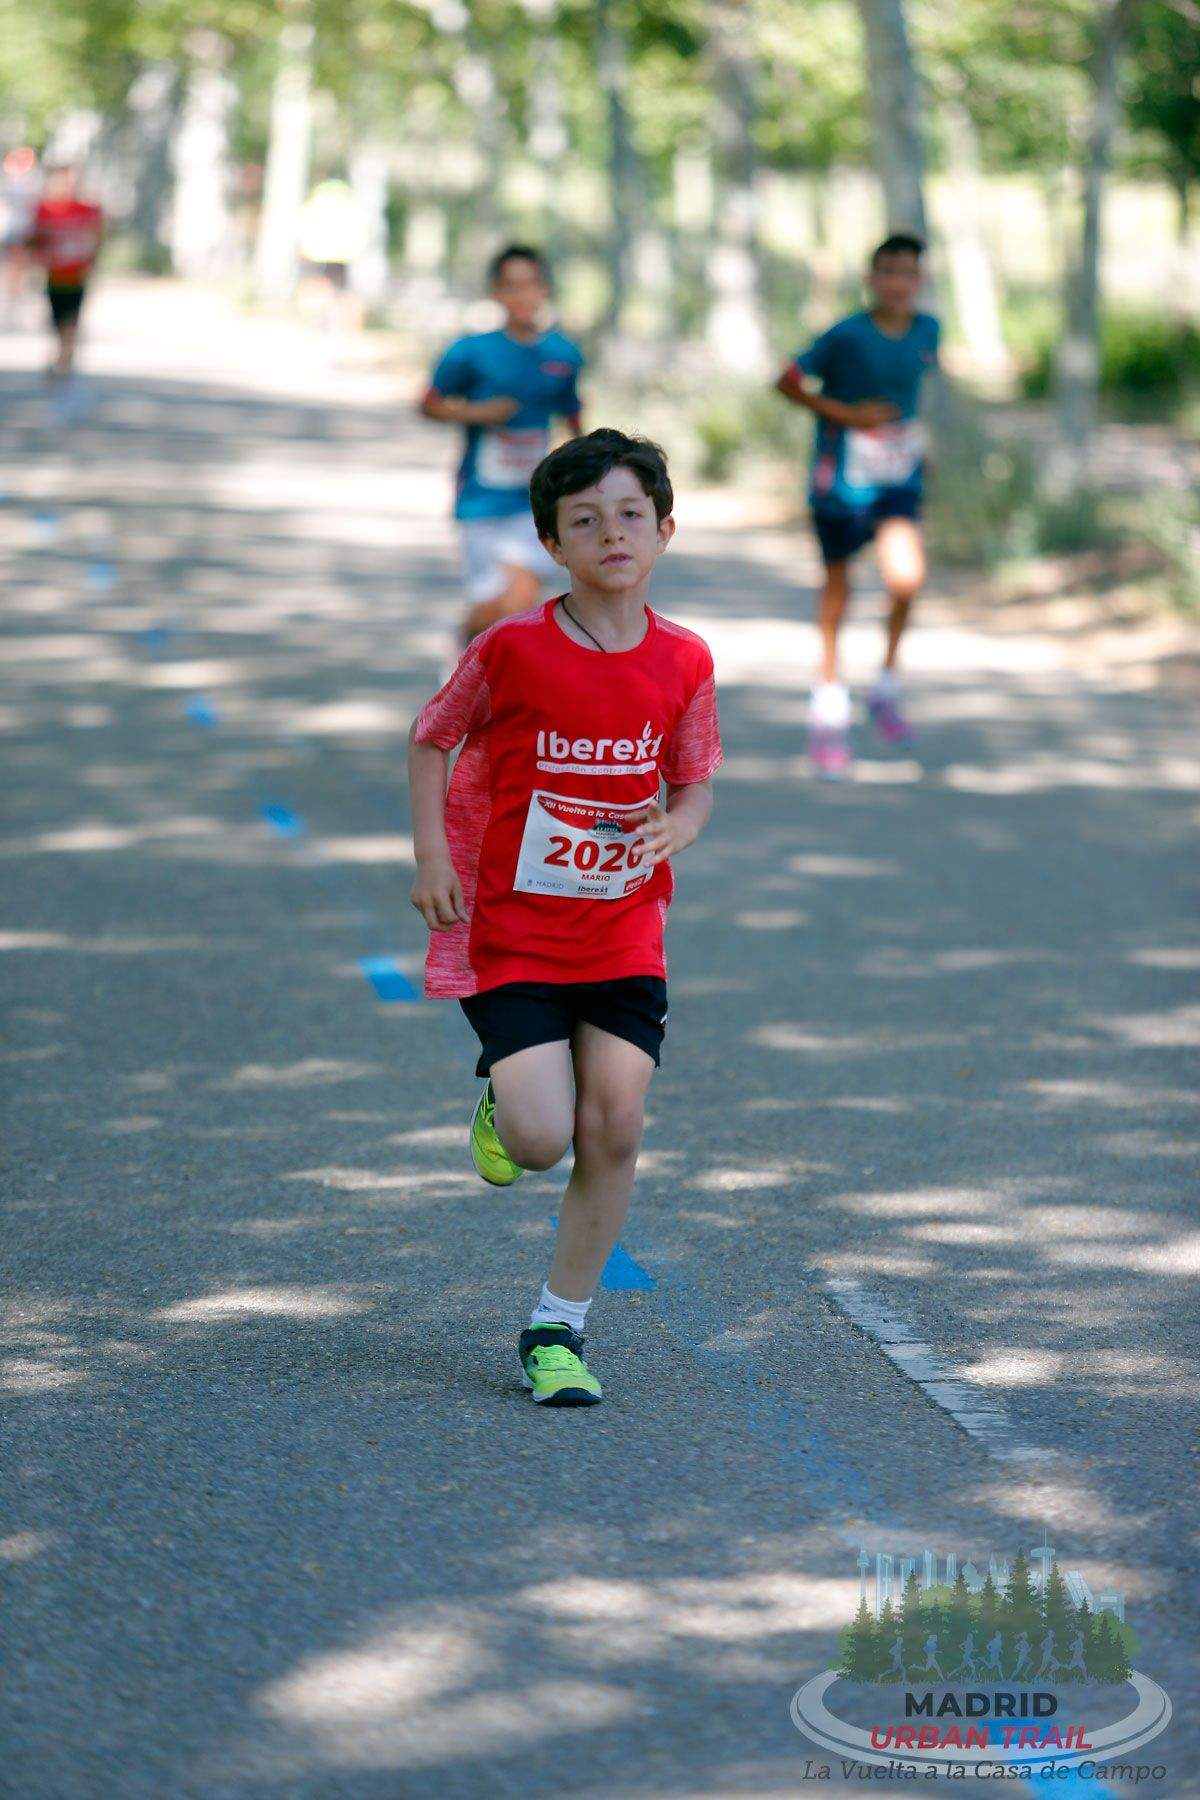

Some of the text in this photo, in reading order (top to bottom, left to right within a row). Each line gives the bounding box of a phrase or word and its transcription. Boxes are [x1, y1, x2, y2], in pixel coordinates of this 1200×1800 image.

[536, 722, 664, 761] Iberext
[591, 766, 622, 774] Contra
[558, 803, 587, 815] Vuelta
[596, 810, 605, 818] la
[608, 812, 625, 820] Cas
[581, 873, 611, 881] MARIO
[535, 881, 564, 890] MADRID
